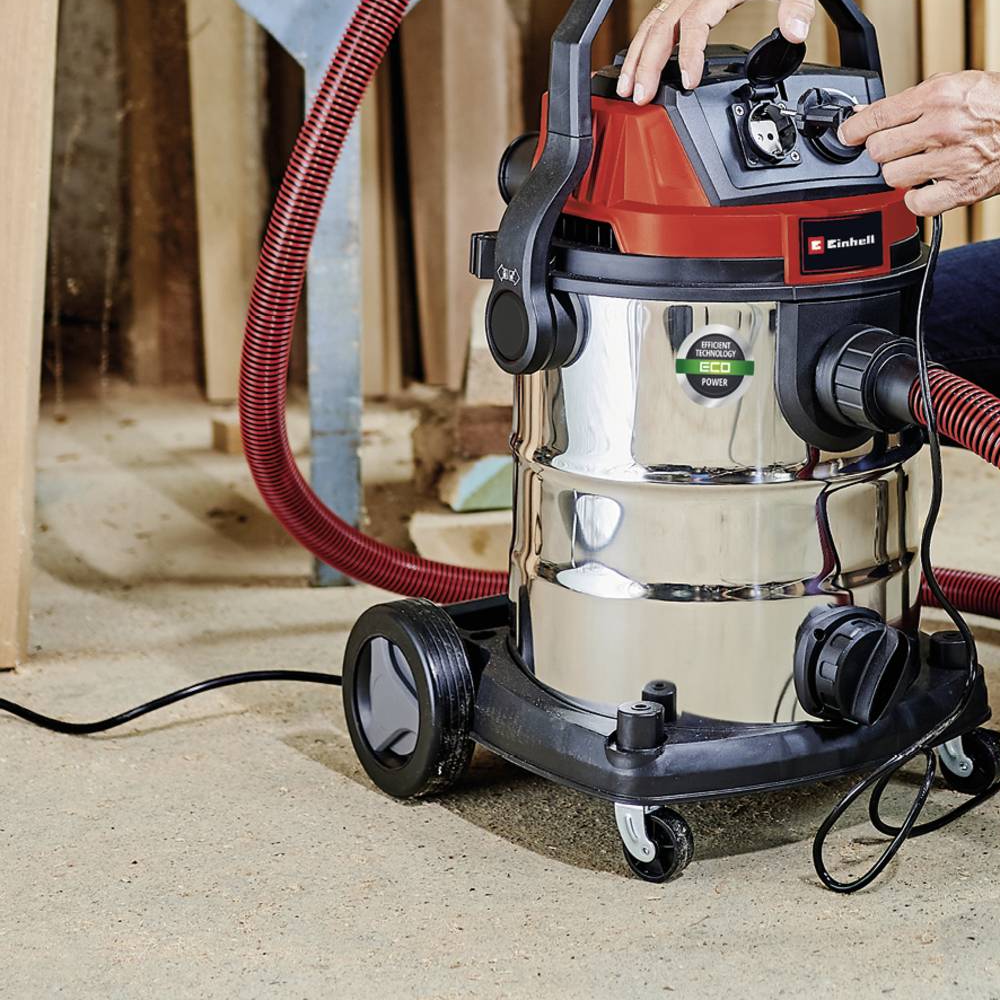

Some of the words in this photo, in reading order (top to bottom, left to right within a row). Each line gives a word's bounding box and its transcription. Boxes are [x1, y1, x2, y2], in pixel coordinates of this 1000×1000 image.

[826, 234, 875, 249] Einhell
[701, 341, 731, 350] EFFICIENT
[695, 349, 737, 358] TECHNOLOGY
[699, 362, 731, 373] ECO
[701, 377, 728, 387] POWER
